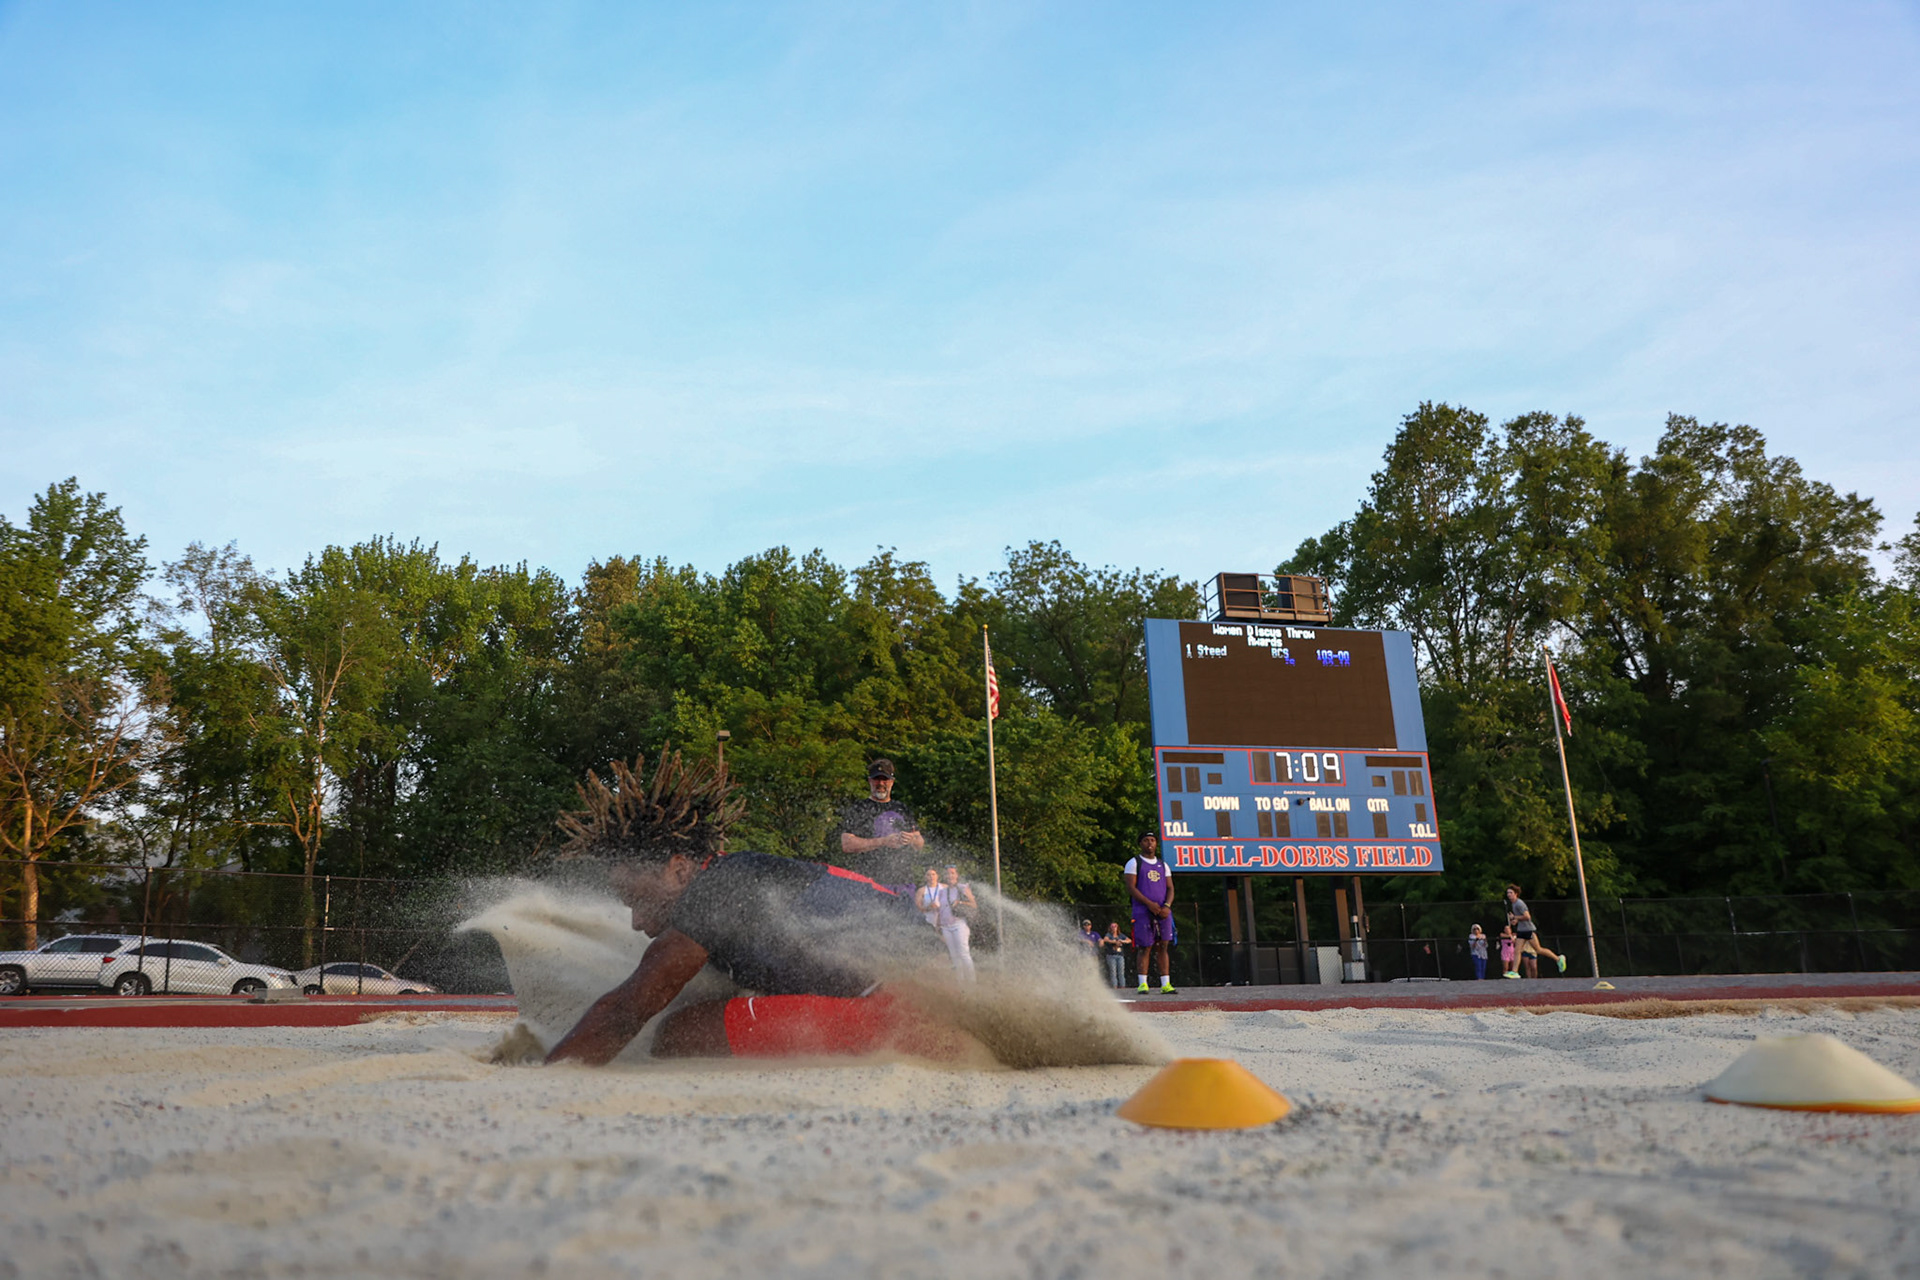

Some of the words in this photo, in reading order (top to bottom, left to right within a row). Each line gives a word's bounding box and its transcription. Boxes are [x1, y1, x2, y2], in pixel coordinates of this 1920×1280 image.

[1212, 624, 1243, 636] Women
[1247, 625, 1282, 638] Discus
[1286, 627, 1315, 640] Throw
[1248, 636, 1283, 648] Awards
[1197, 644, 1227, 656] Steed
[1275, 752, 1341, 782] 7:09
[1203, 796, 1240, 810] DOWN
[1254, 797, 1271, 811] TO
[1272, 797, 1290, 811] GO
[1309, 798, 1335, 811] BALL
[1335, 798, 1350, 812] ON
[1366, 798, 1389, 812] QTR
[1163, 821, 1194, 836] T.O.L.
[1408, 823, 1437, 838] T.O.L.
[1174, 845, 1350, 867] HULL-DOBBS
[1353, 846, 1433, 867] FIELD
